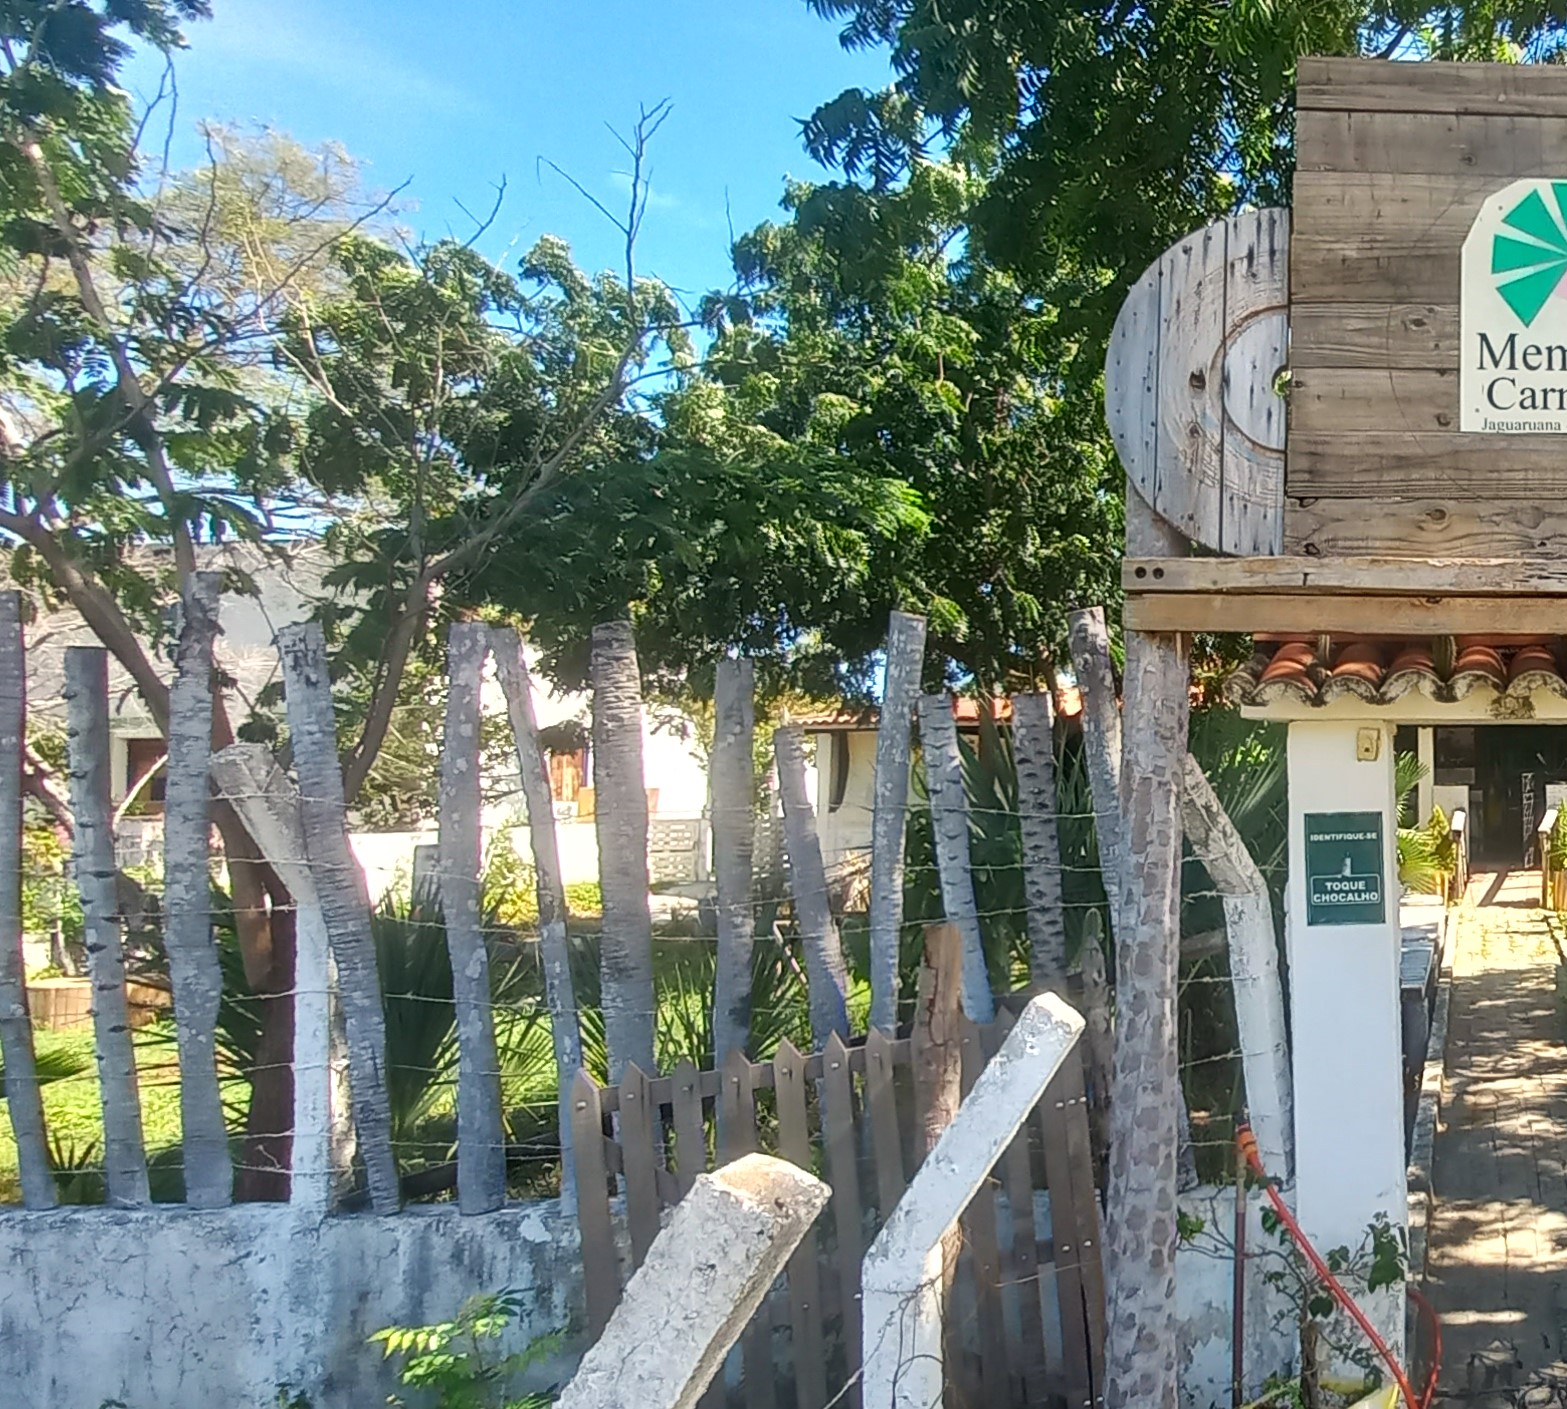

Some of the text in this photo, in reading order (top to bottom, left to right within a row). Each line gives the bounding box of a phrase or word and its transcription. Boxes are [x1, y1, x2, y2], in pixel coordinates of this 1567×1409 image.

[1481, 418, 1561, 433] Jaguaruana
[1310, 832, 1377, 841] IDENTIFIQUE-SE
[1325, 881, 1366, 891] TOQUE
[1313, 892, 1378, 903] CHOCALHO
